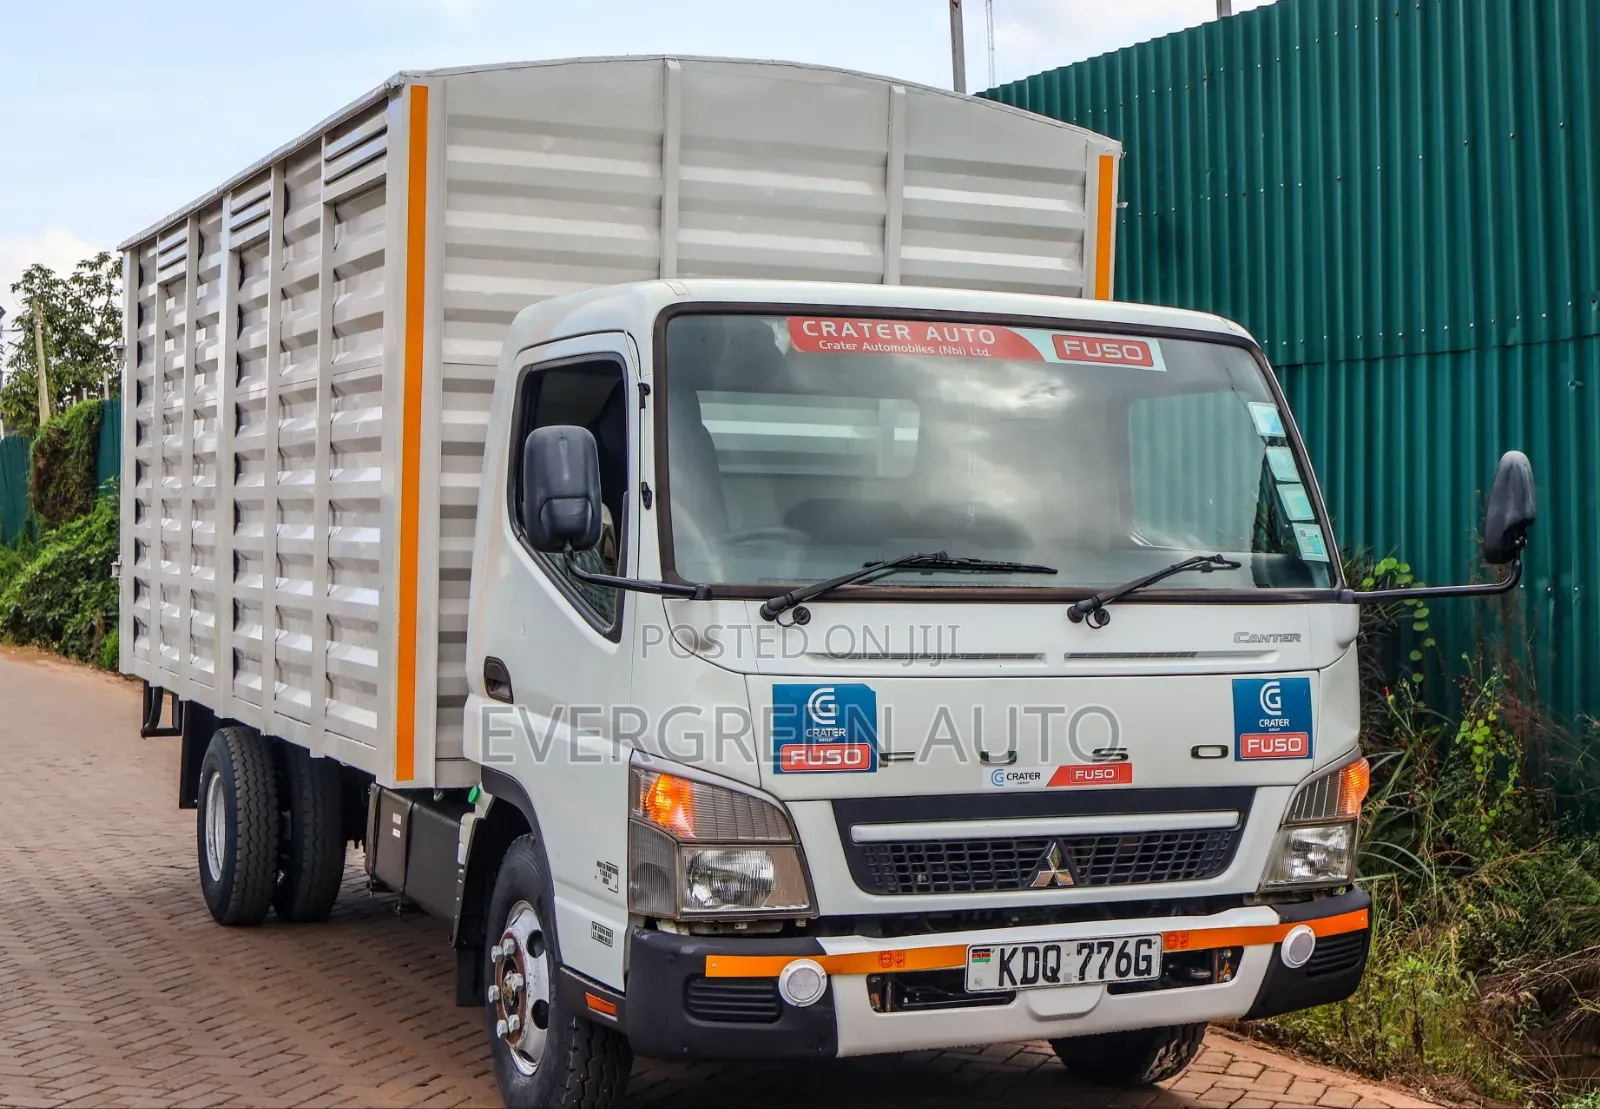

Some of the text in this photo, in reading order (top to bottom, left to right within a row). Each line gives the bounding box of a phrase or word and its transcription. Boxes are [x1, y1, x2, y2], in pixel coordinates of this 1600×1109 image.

[802, 320, 996, 345] CRATER AUTO
[819, 340, 992, 357] Crater Automobiles (Nbi) Ltd.
[1063, 339, 1144, 361] FUSO
[1259, 718, 1290, 728] CRATER
[806, 727, 846, 738] CRATER
[1247, 737, 1302, 753] FUSO
[790, 748, 862, 766] FUSO
[1006, 772, 1041, 781] CRATER
[1075, 769, 1115, 780] FUSO
[998, 944, 1062, 987] KDQ
[1076, 938, 1153, 982] 776G
